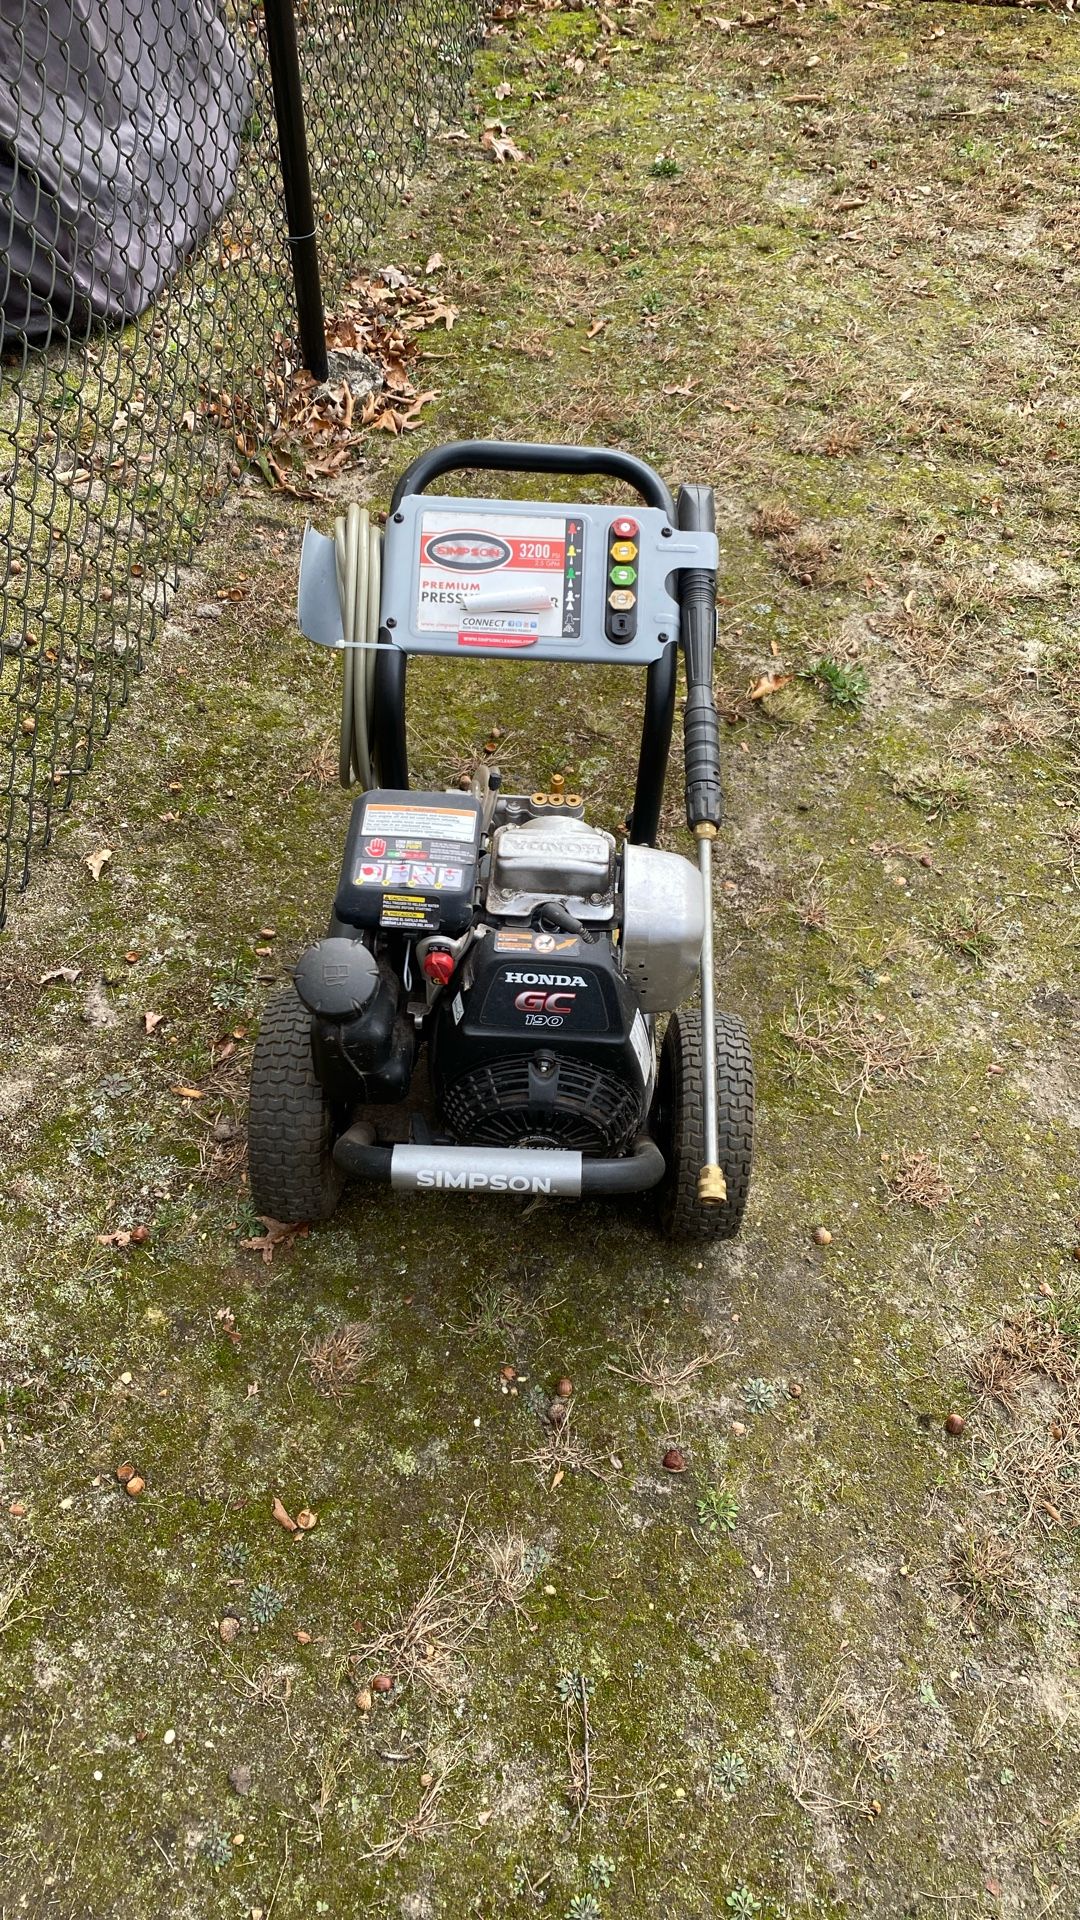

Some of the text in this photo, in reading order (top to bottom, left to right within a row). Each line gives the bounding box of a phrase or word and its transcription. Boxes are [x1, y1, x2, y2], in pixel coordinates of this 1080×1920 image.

[436, 546, 501, 558] SIMPSON
[519, 543, 551, 559] 3200
[422, 581, 480, 591] PREMIUM
[462, 617, 506, 628] CONNECT
[505, 972, 588, 987] HONDA
[514, 990, 577, 1014] GC
[525, 1014, 564, 1027] 190
